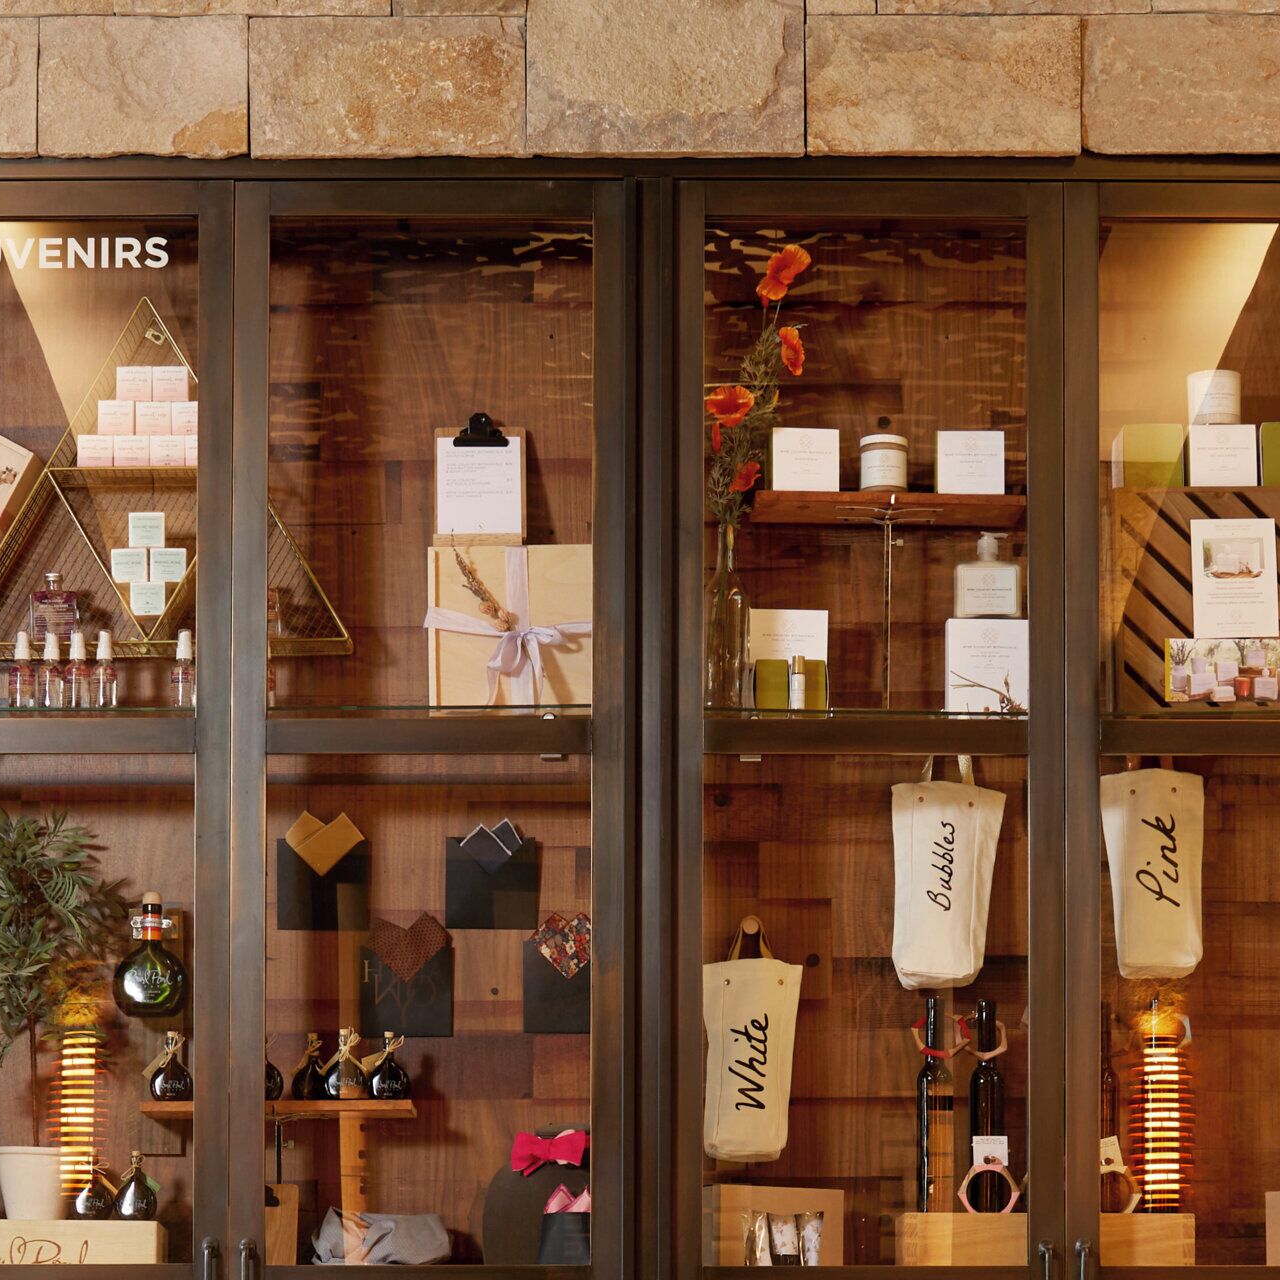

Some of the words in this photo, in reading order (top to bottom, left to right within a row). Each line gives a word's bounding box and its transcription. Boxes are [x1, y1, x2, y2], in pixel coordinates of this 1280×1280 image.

[925, 820, 955, 912] Bubbles
[1134, 812, 1178, 908] Pink
[734, 1012, 769, 1112] White
